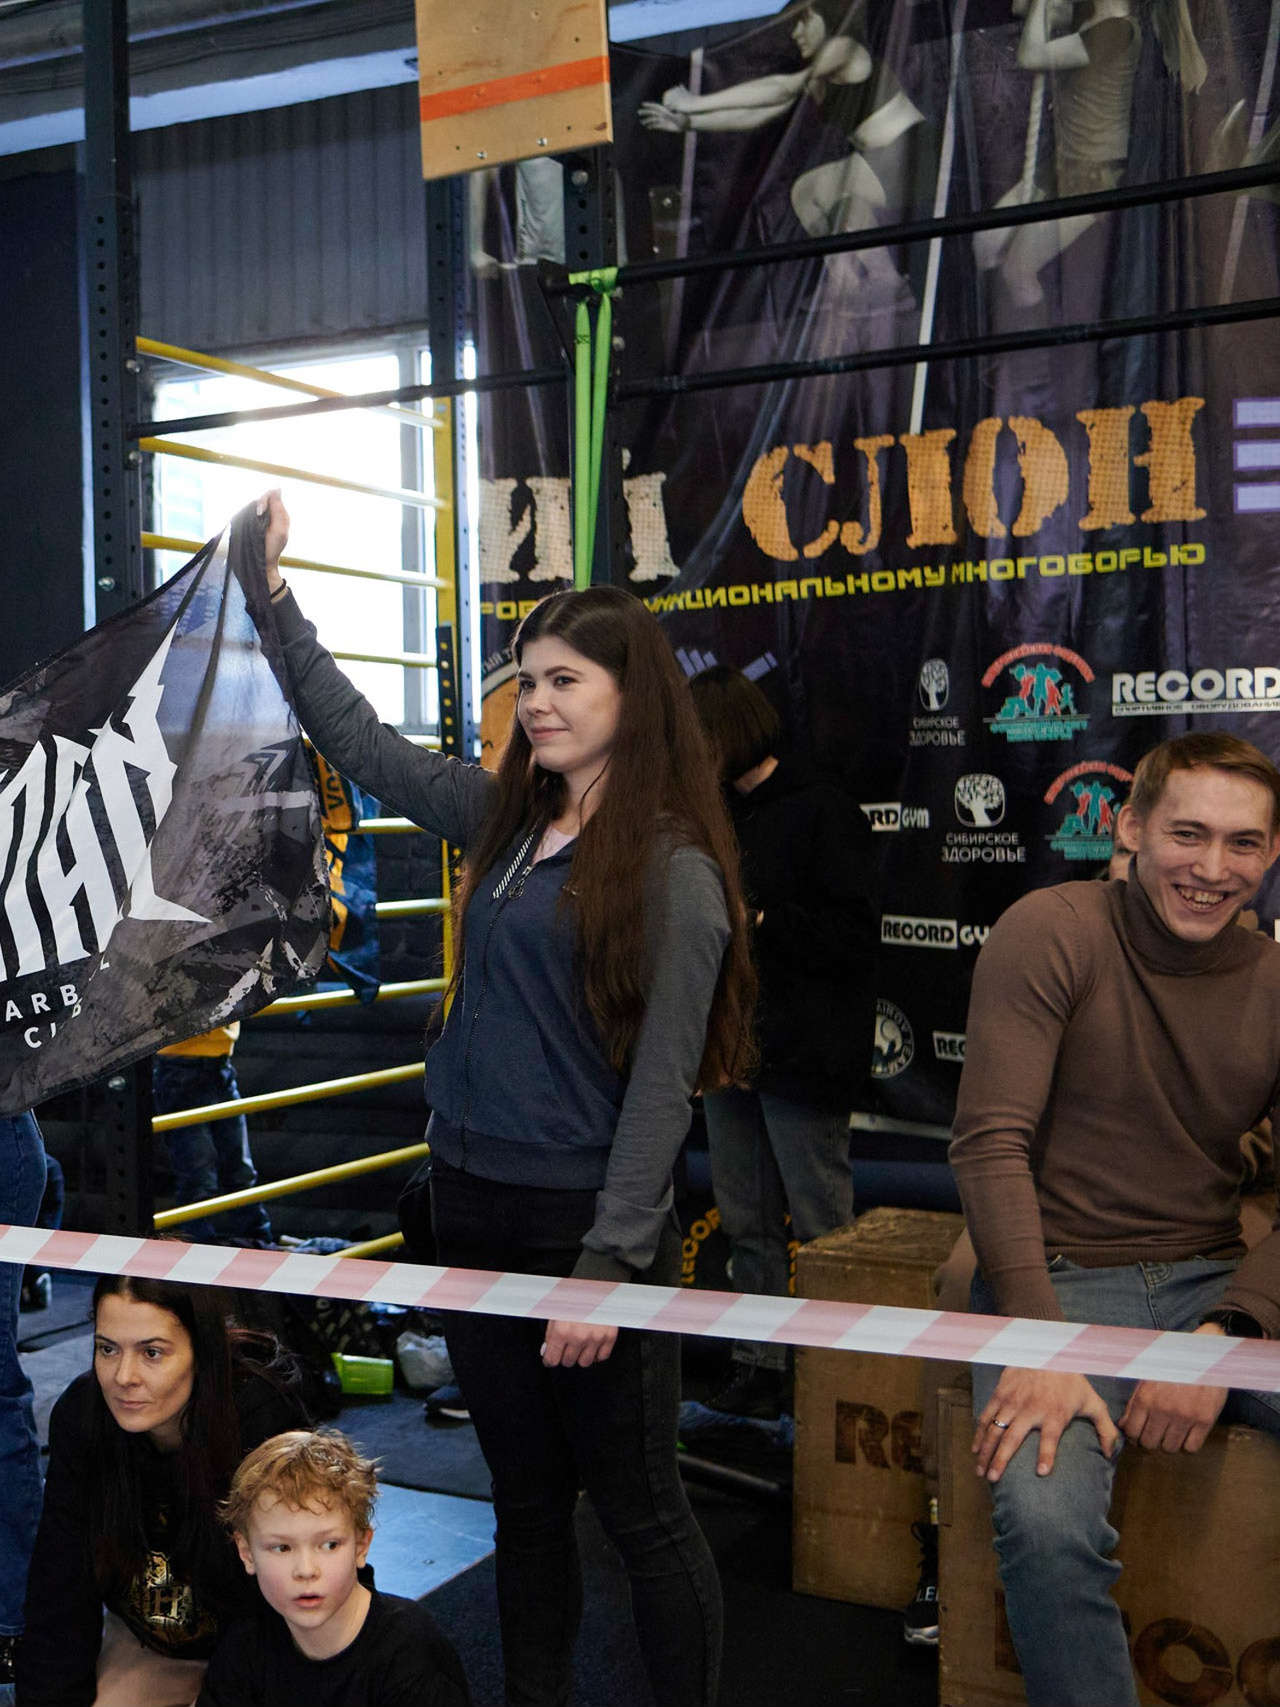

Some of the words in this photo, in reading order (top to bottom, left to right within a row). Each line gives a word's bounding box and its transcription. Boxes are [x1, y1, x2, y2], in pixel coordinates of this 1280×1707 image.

[742, 397, 1208, 562] СЛОН
[951, 543, 1206, 585] МНОГОБОРЬЮ
[1112, 667, 1280, 703] RECORD
[909, 730, 966, 747] ЗДОРОВЬЕ
[946, 832, 1019, 846] СИБИРСКОЕ
[941, 846, 1026, 863] ЗДОРОВЬЕ
[882, 919, 956, 944] RECORD
[959, 924, 991, 946] GY
